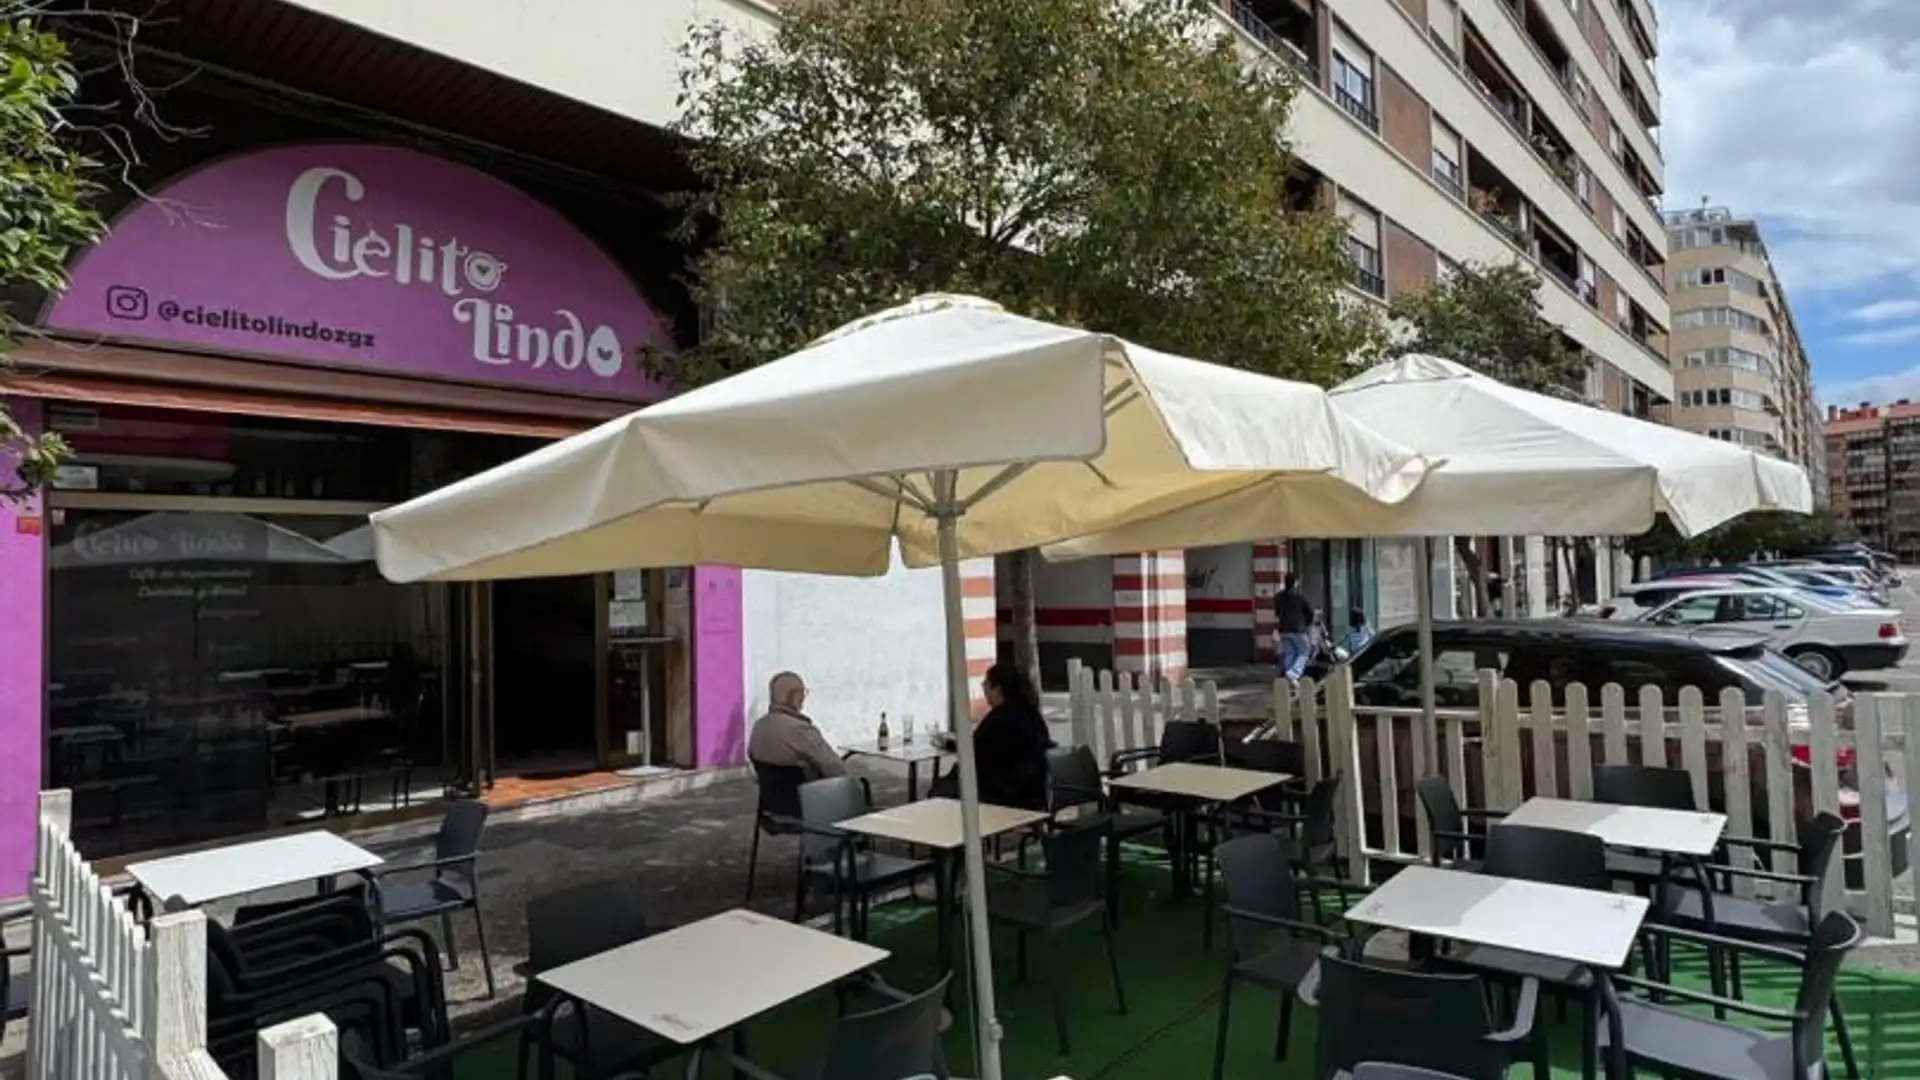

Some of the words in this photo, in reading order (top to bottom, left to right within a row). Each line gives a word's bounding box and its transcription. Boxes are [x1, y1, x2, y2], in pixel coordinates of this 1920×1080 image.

[286, 167, 507, 295] Cielito
[157, 300, 376, 349] @cielitolindozgz
[453, 298, 622, 378] Lindo
